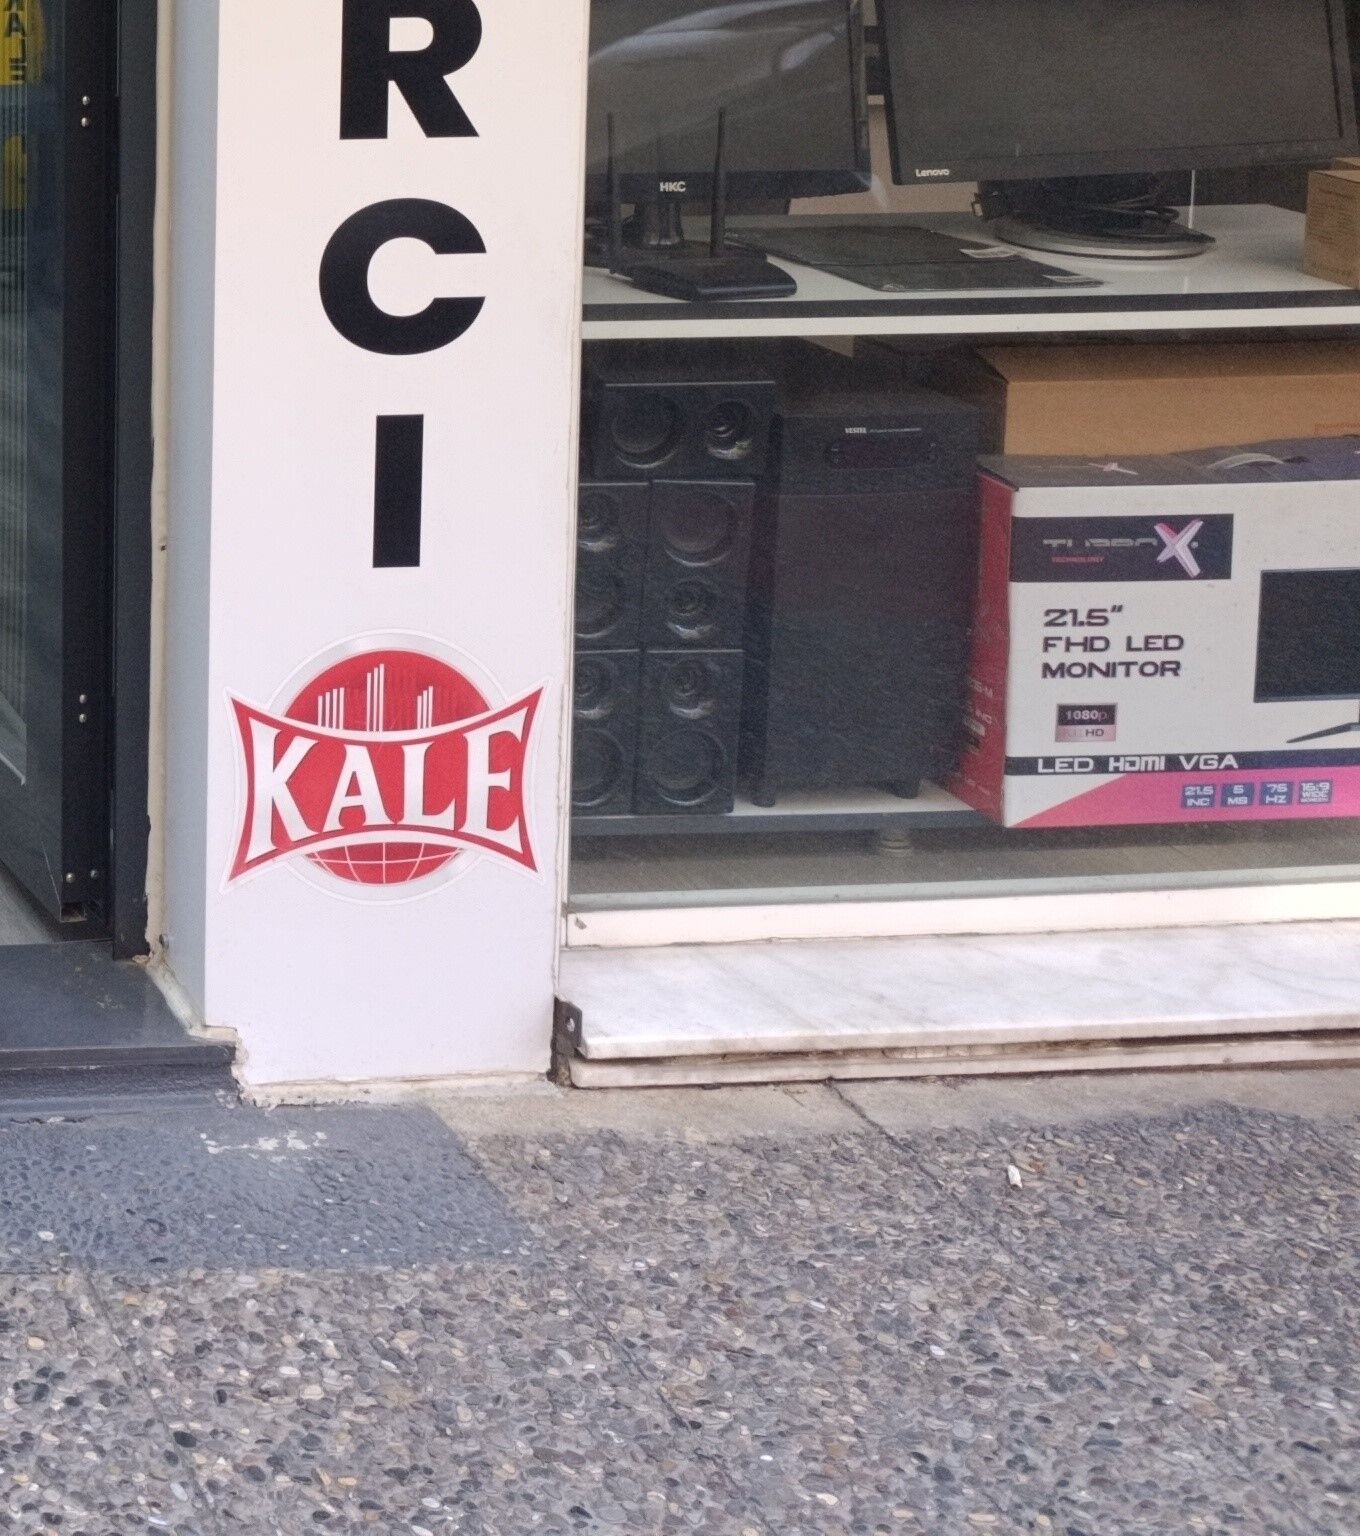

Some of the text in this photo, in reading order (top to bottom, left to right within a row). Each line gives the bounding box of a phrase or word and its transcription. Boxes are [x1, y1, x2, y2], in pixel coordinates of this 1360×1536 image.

[915, 168, 950, 178] Lenovo
[659, 180, 687, 193] HKC
[1042, 634, 1185, 653] FHD LED
[1041, 660, 1182, 679] MONITOR
[1065, 709, 1108, 723] 1080p
[1037, 753, 1239, 773] LED HDMI VGA
[244, 706, 530, 865] KALE
[1184, 785, 1214, 796] 21.5
[1265, 783, 1288, 793] 75
[1301, 782, 1330, 791] 16:9
[1301, 790, 1329, 798] WIDE
[1186, 797, 1210, 806] INC
